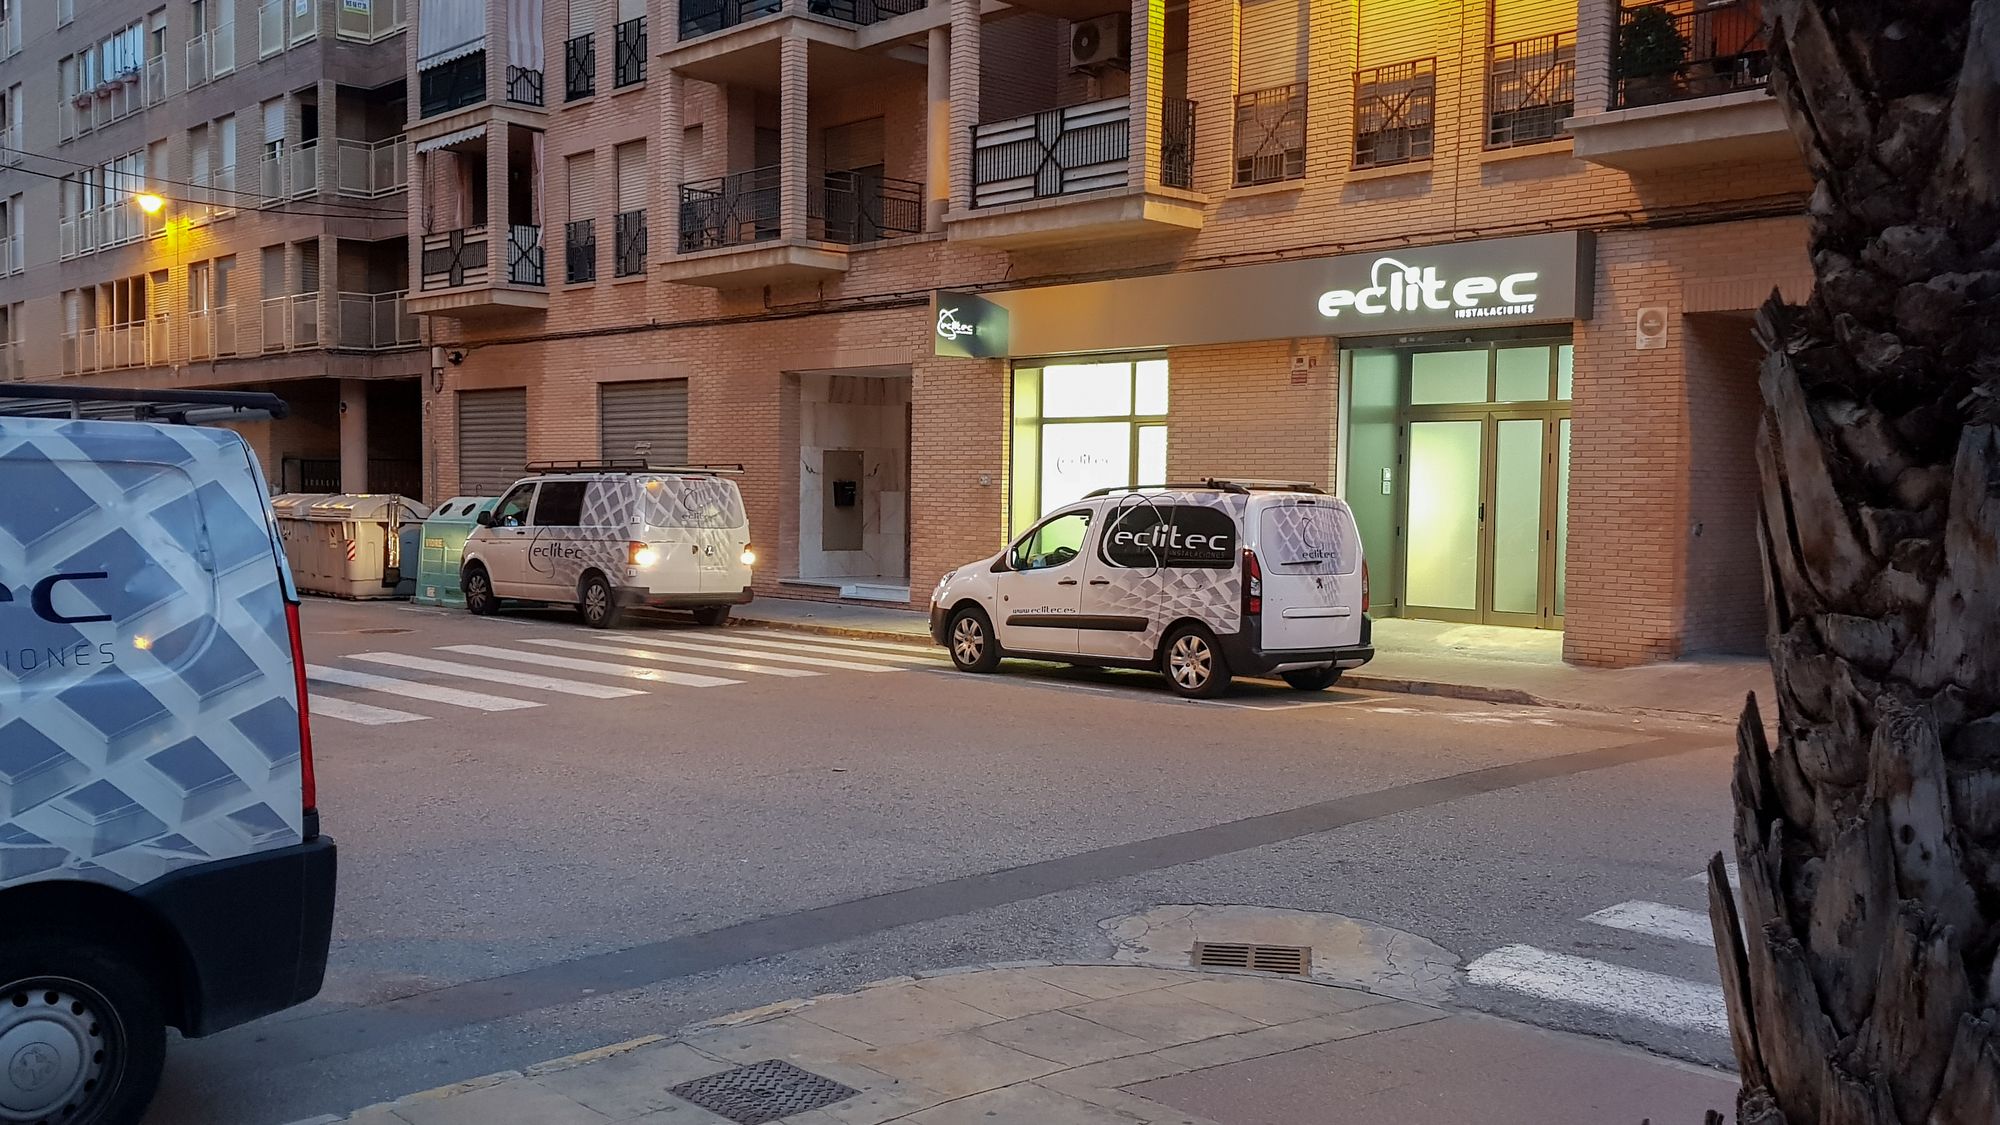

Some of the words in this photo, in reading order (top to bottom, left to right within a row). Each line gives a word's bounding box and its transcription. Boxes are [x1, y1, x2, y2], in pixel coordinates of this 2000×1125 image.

[1318, 265, 1538, 317] eclitec
[1455, 304, 1535, 319] INSTALACIONES
[1114, 524, 1228, 550] eclitec
[533, 542, 583, 559] eclitec
[1302, 549, 1336, 559] eclitec
[0, 571, 113, 624] c
